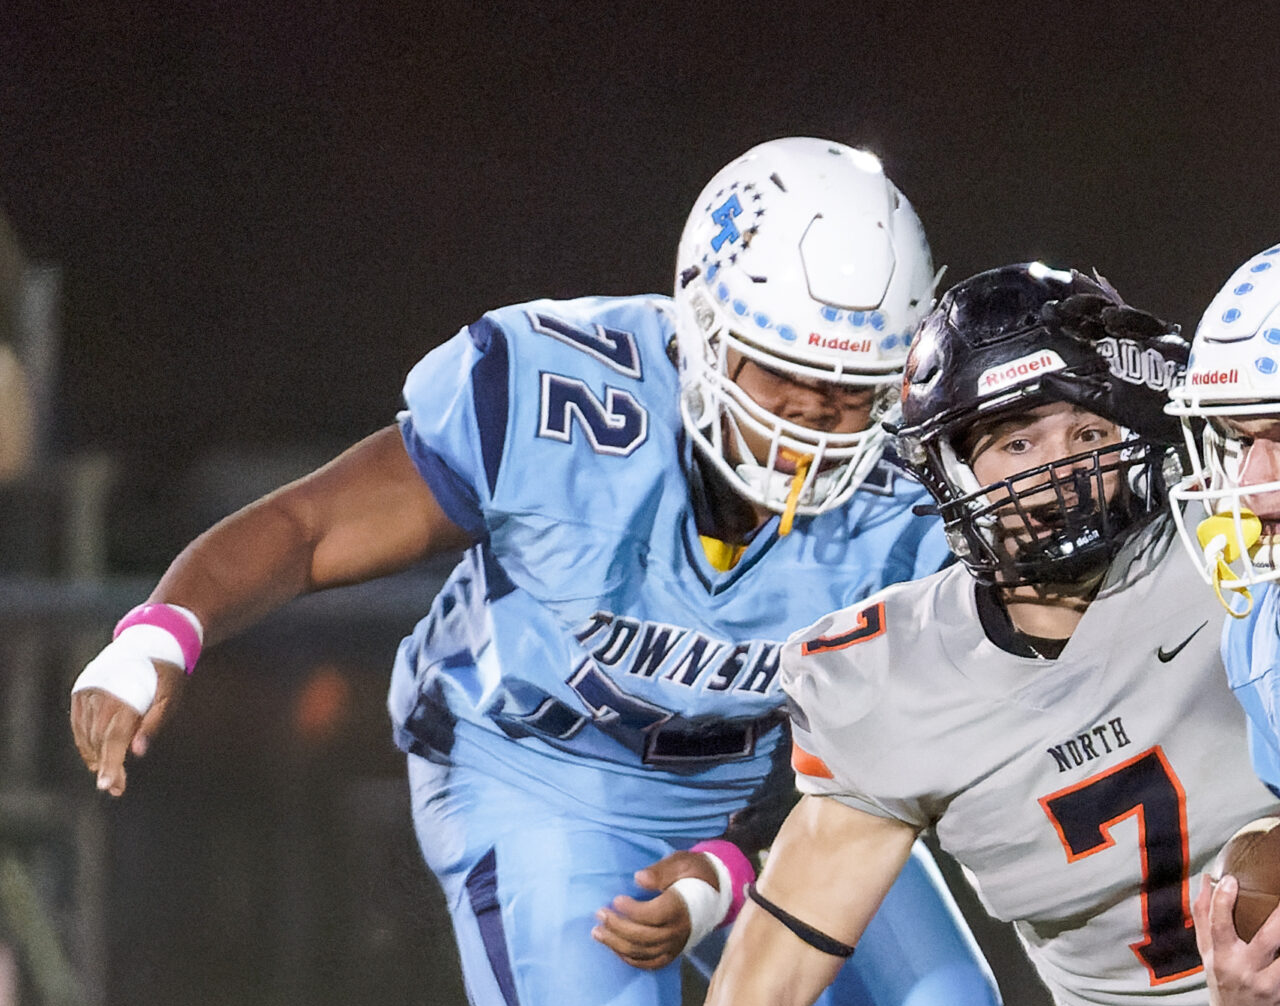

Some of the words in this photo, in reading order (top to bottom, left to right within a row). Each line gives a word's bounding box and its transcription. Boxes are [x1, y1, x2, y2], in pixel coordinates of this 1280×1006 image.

[808, 332, 872, 354] Riddell
[523, 310, 651, 459] 72
[985, 355, 1053, 389] Riddell
[1191, 368, 1239, 386] Riddell
[801, 600, 887, 656] 7
[1046, 716, 1132, 773] NORTH
[1037, 744, 1203, 986] 7
